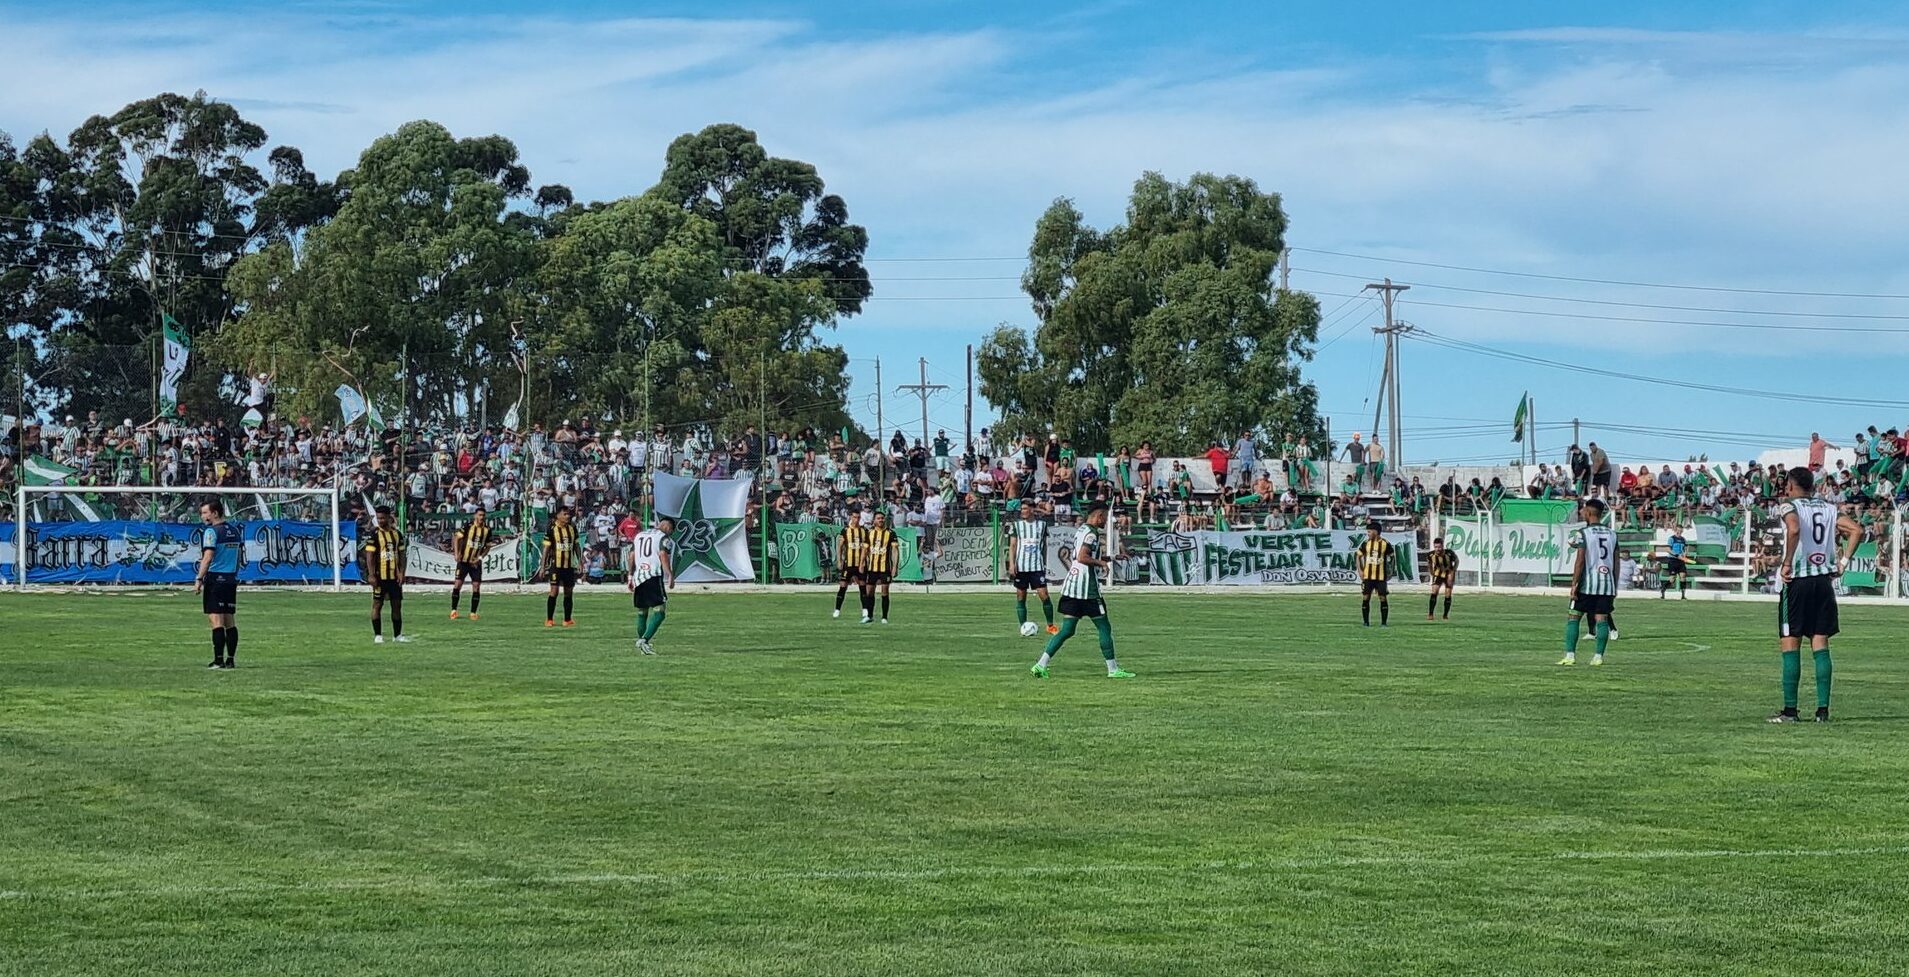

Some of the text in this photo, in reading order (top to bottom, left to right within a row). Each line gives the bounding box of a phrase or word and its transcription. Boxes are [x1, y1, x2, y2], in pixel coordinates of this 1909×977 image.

[675, 519, 713, 553] 23
[1812, 511, 1826, 545] 6
[638, 536, 653, 558] 10
[1150, 535, 1192, 550] CAG
[1243, 533, 1333, 550] VERTE
[1598, 537, 1609, 560] 5
[944, 548, 994, 562] ENFERMEDA
[1204, 542, 1305, 582] FESTEJAR
[1261, 568, 1358, 583] DON OSVALDO
